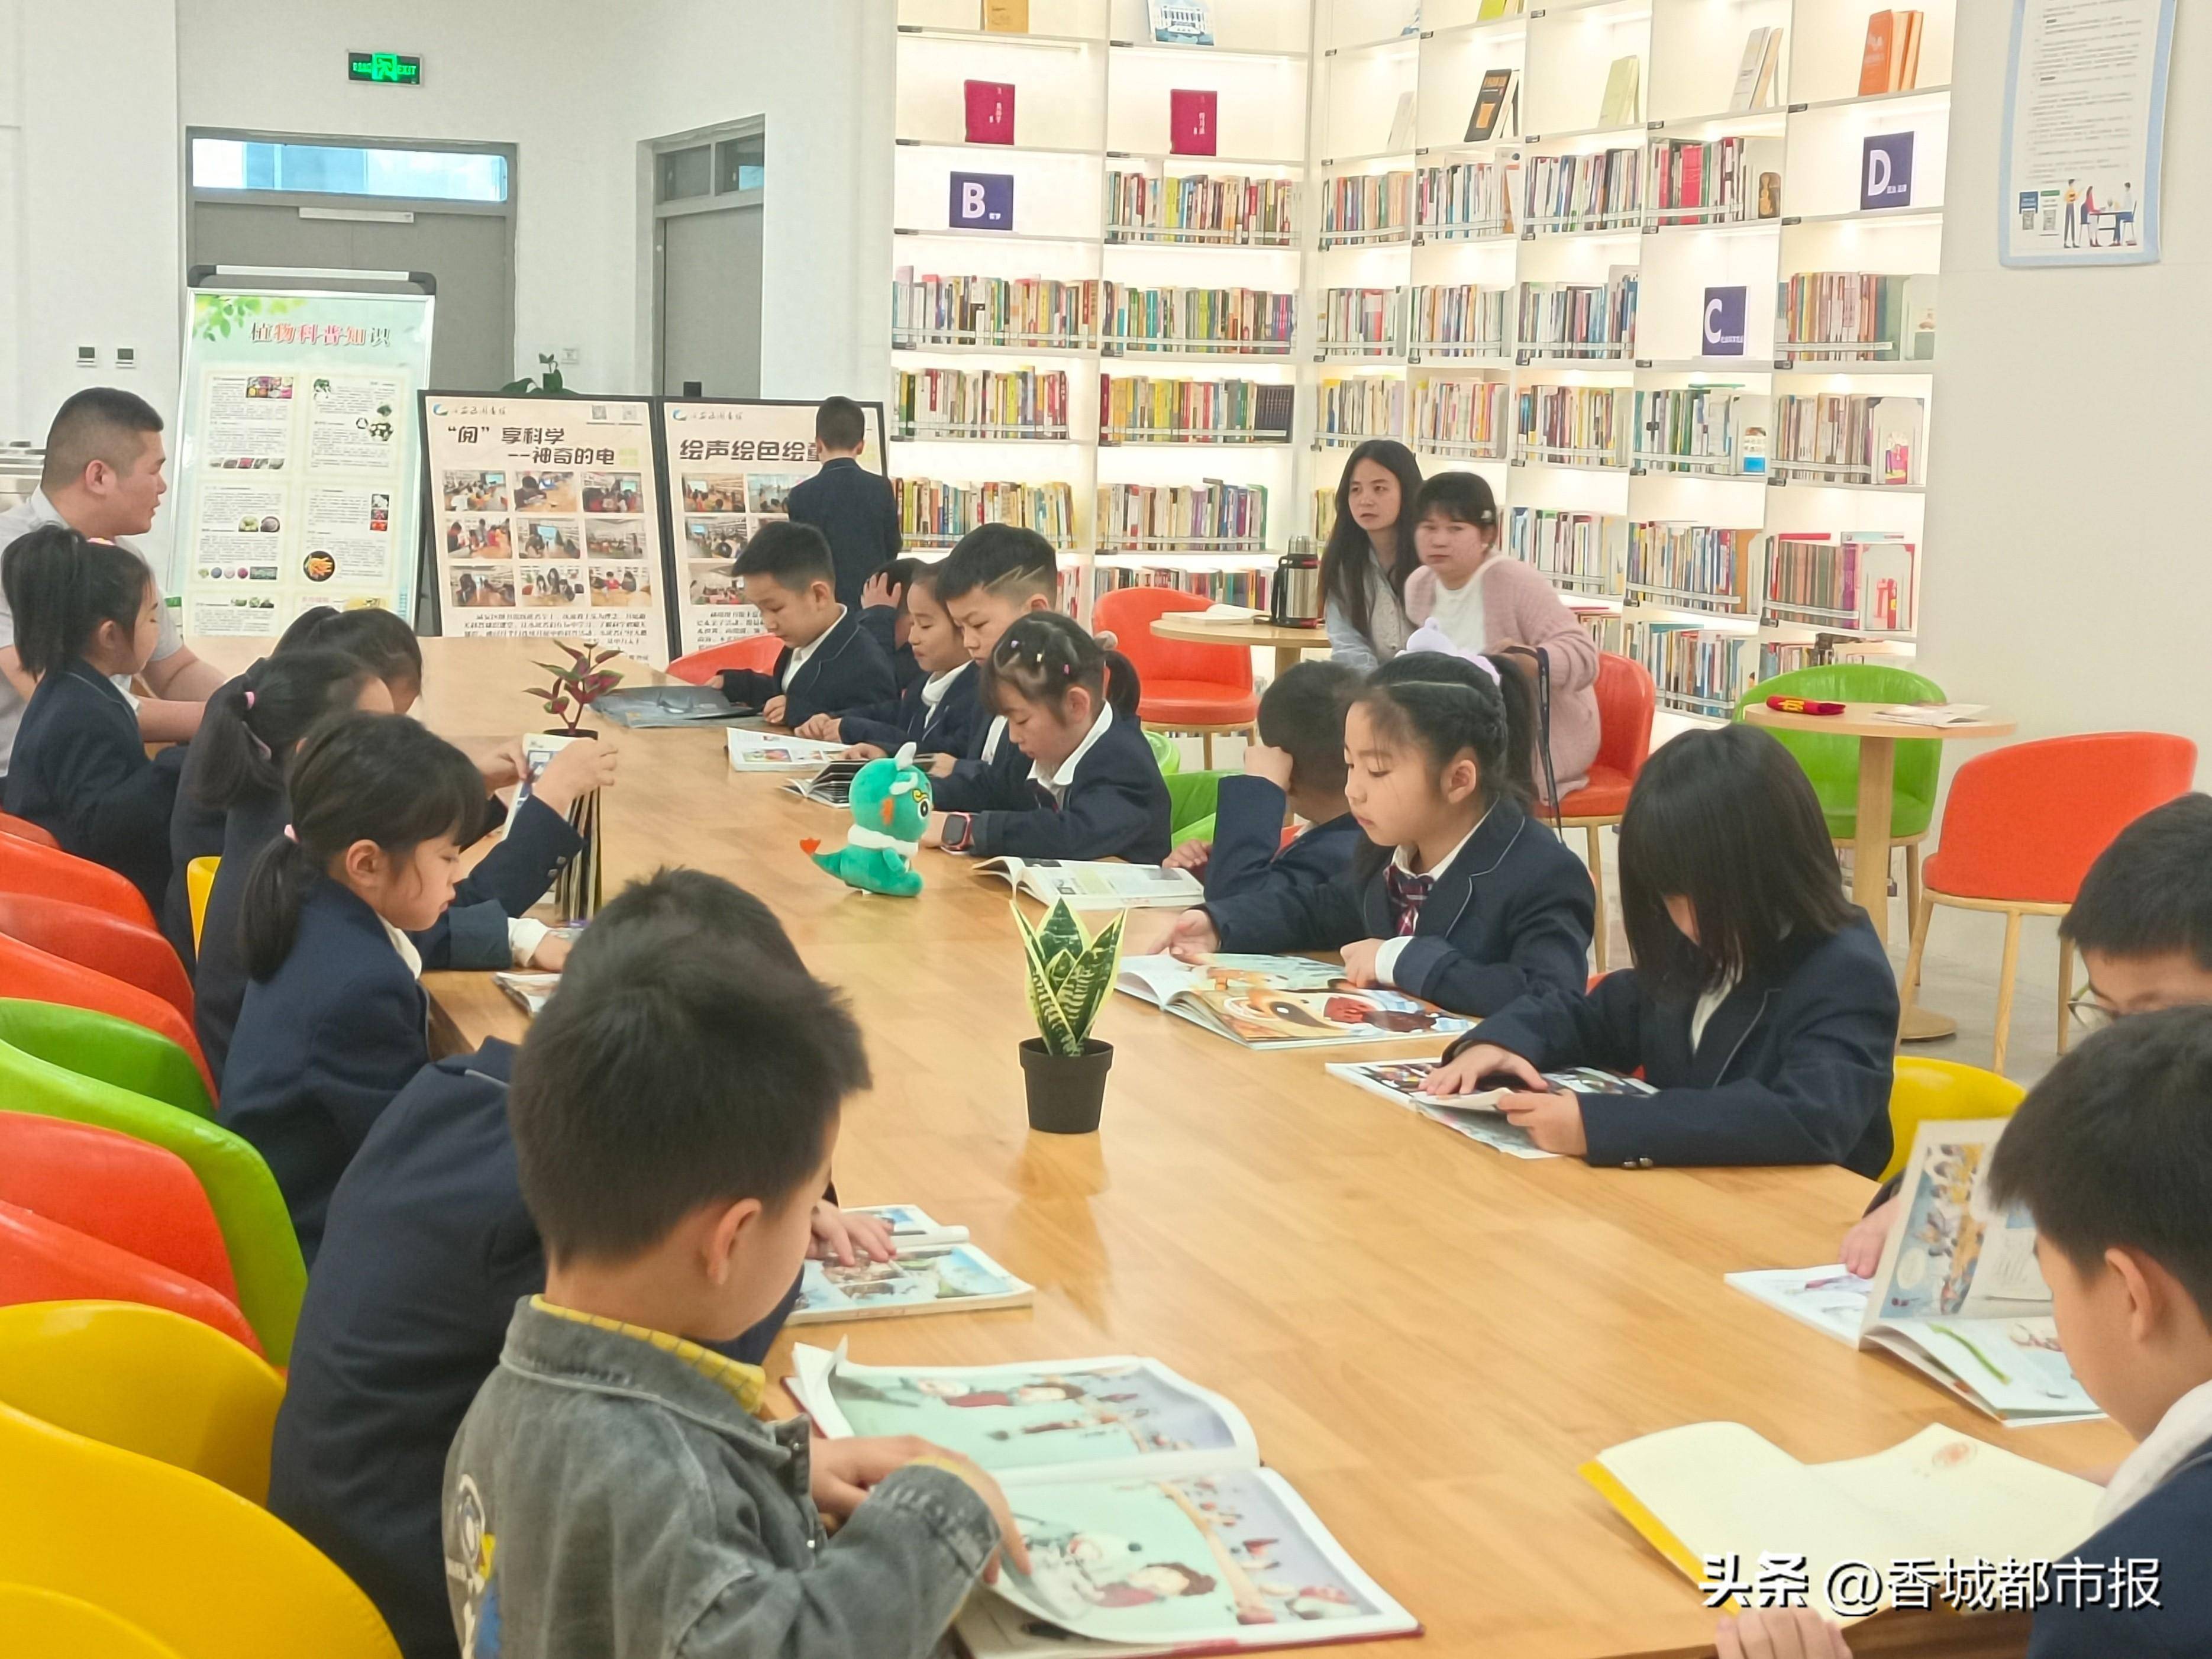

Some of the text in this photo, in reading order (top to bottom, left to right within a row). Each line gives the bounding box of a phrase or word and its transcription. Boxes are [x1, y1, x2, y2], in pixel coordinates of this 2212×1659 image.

[1868, 149, 1891, 196] D
[962, 182, 986, 219] B
[251, 322, 391, 347] 植物科普知识
[1704, 298, 1722, 344] C
